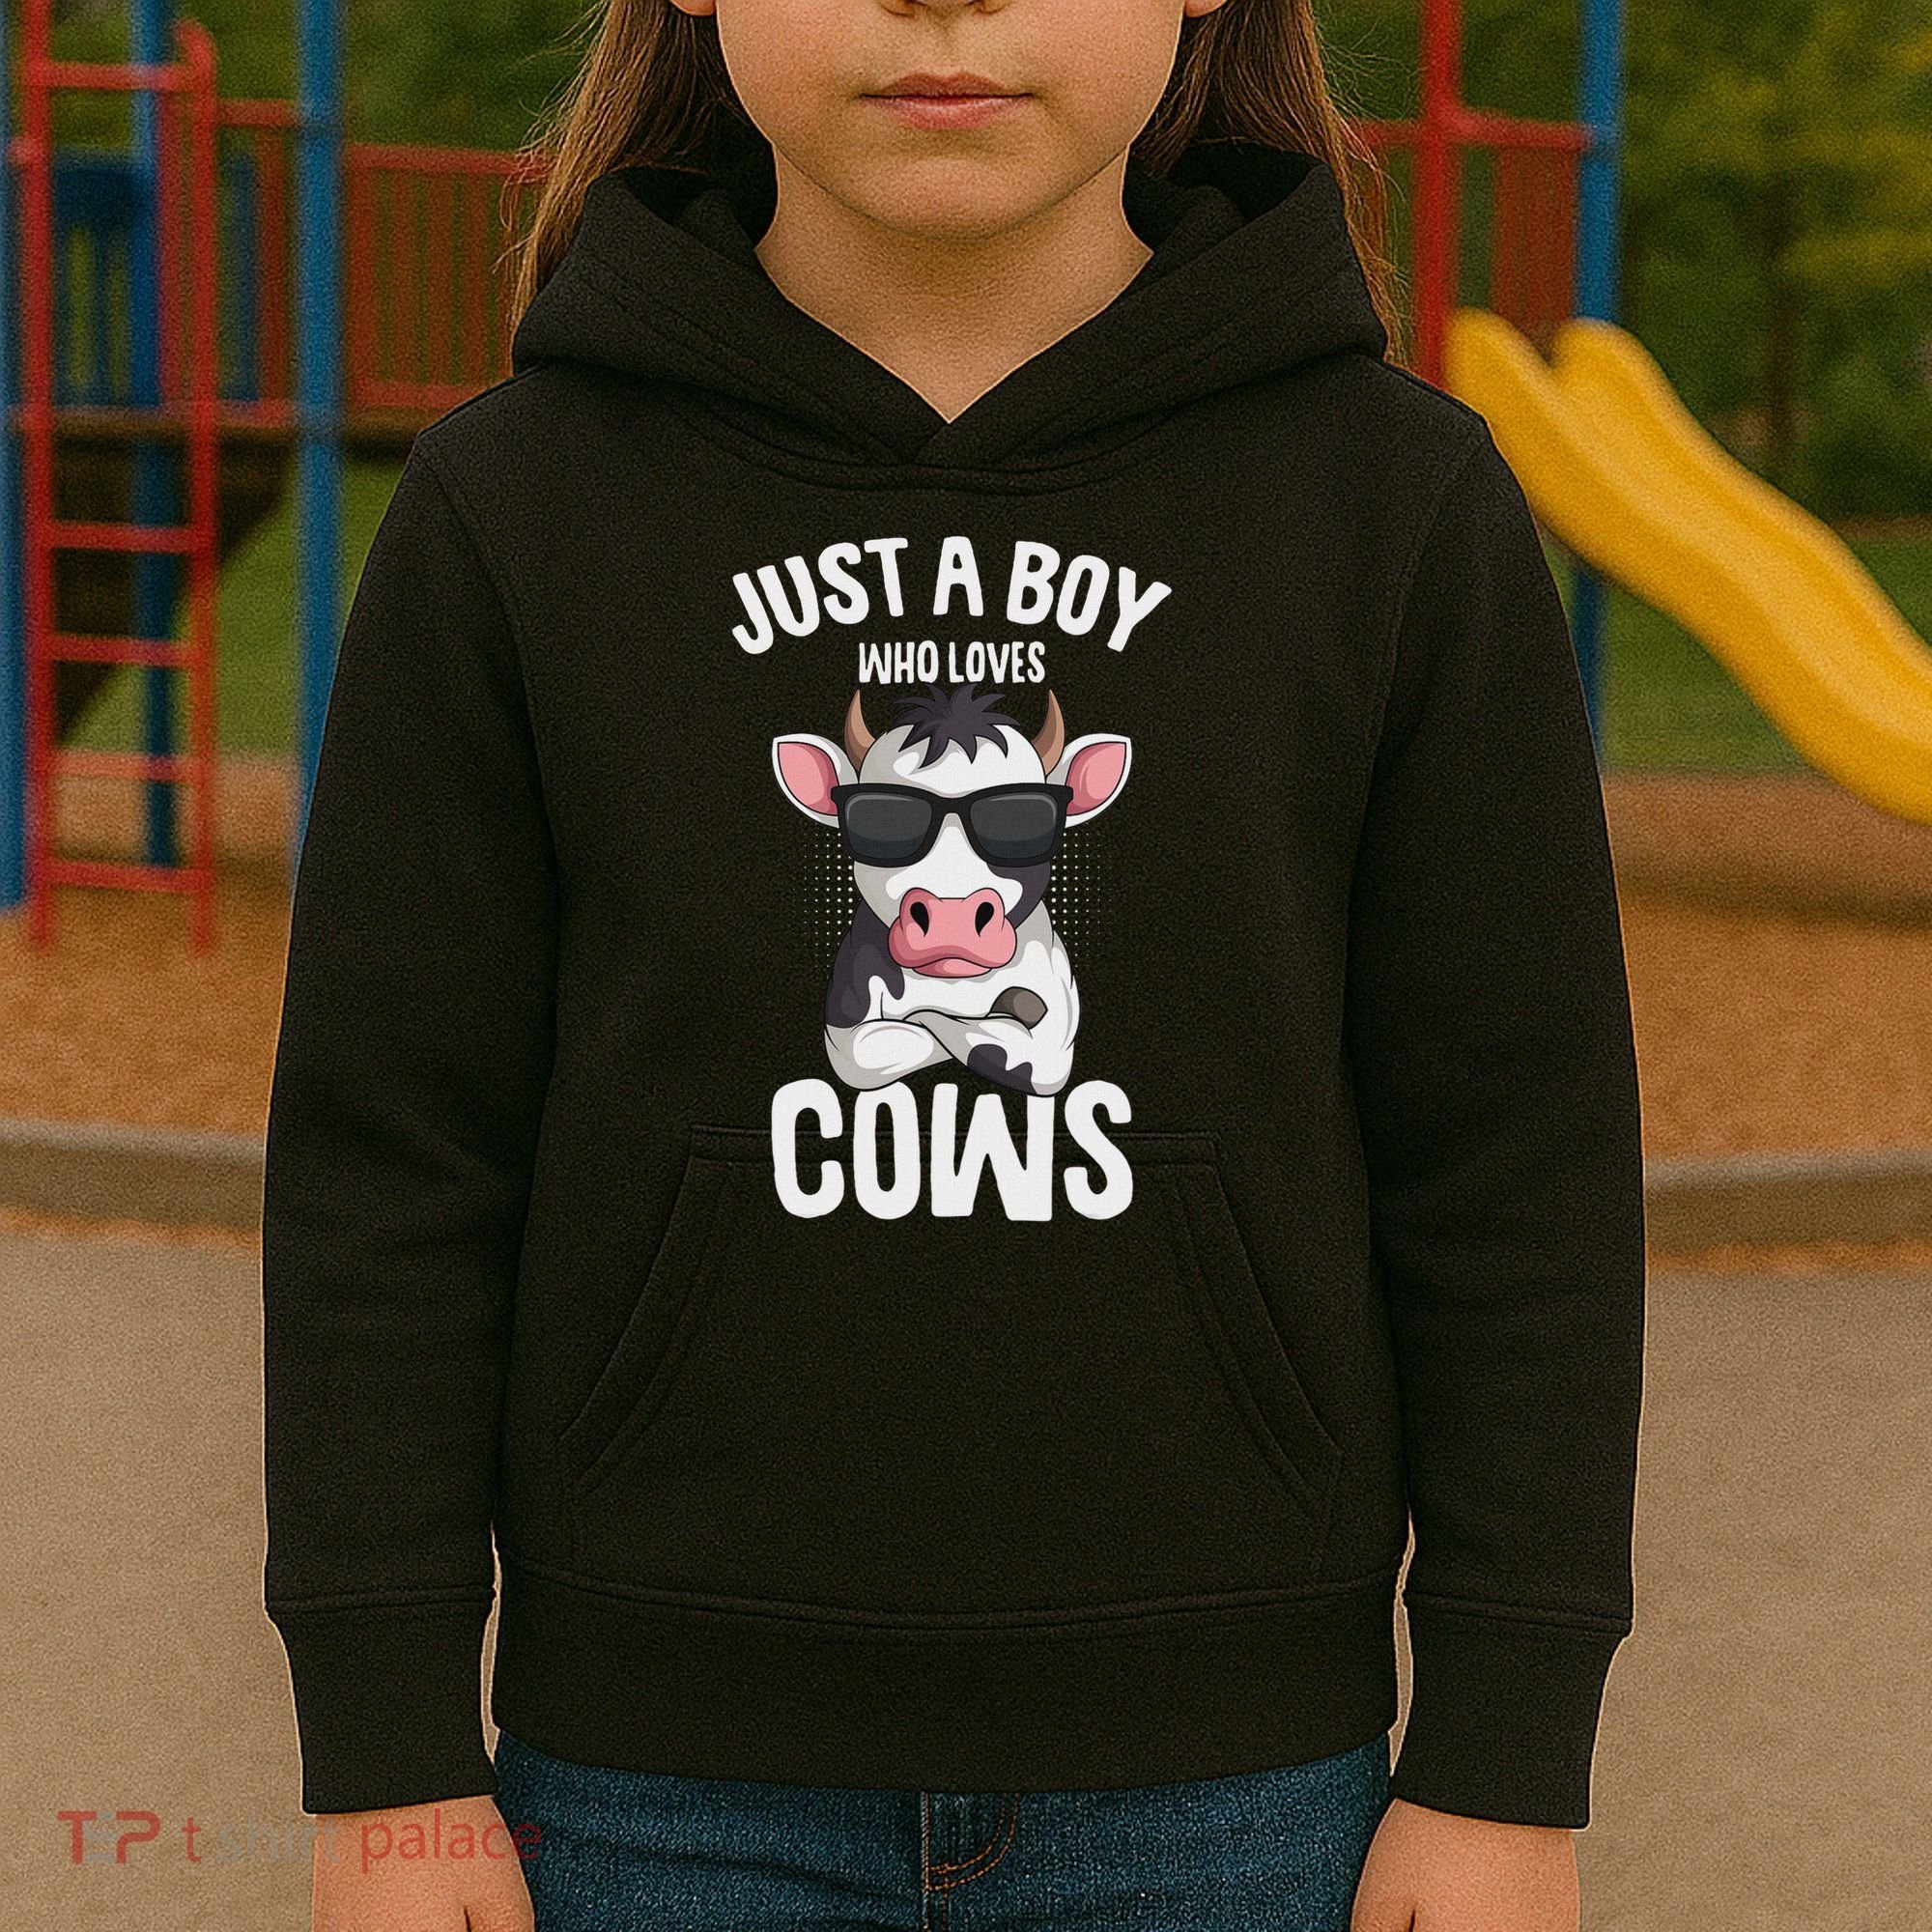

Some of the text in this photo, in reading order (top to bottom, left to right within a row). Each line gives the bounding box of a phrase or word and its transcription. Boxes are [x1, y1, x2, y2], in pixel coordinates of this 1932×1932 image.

[731, 535, 1173, 655] JUST A BOY
[858, 640, 1046, 684] WHO LOVES
[771, 1078, 1134, 1222] COWS
